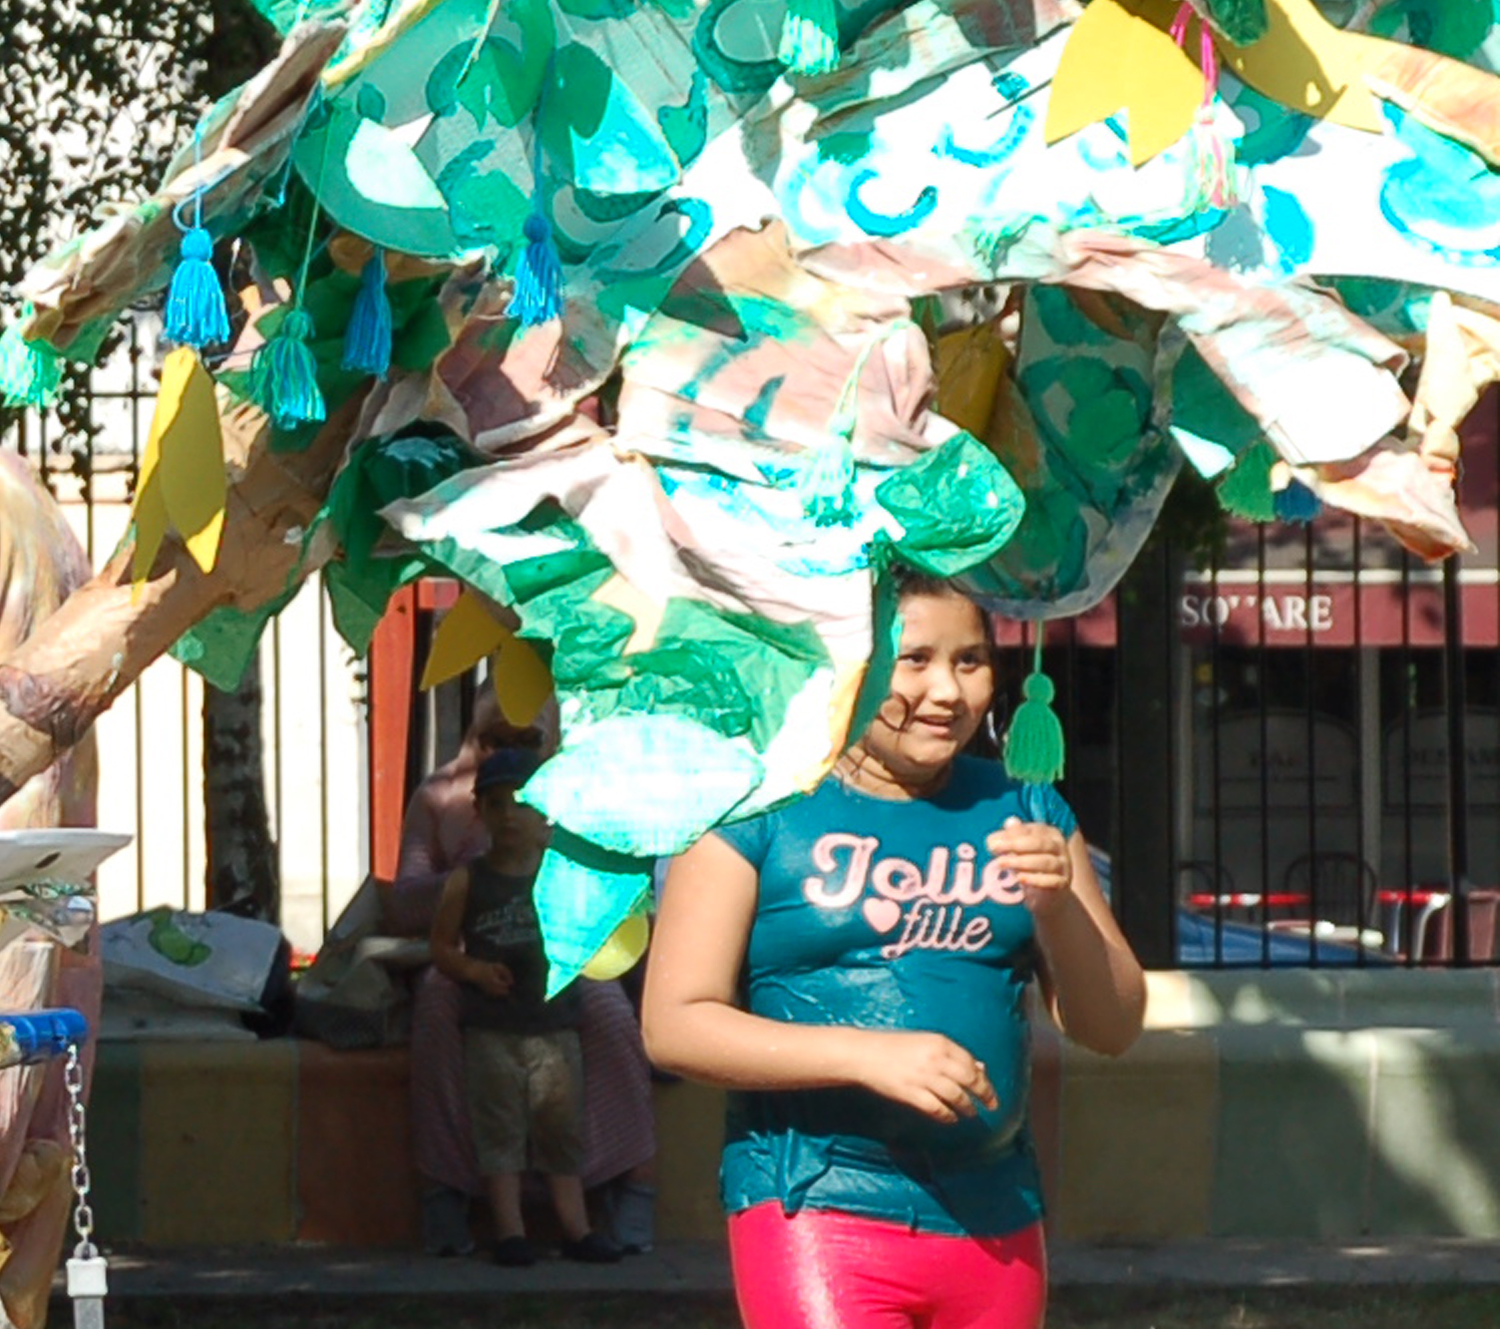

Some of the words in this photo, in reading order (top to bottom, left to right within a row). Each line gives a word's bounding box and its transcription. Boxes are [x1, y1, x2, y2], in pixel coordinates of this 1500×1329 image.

[1181, 594, 1333, 633] SQARE
[804, 832, 1025, 908] Jolie
[880, 897, 993, 960] fille
